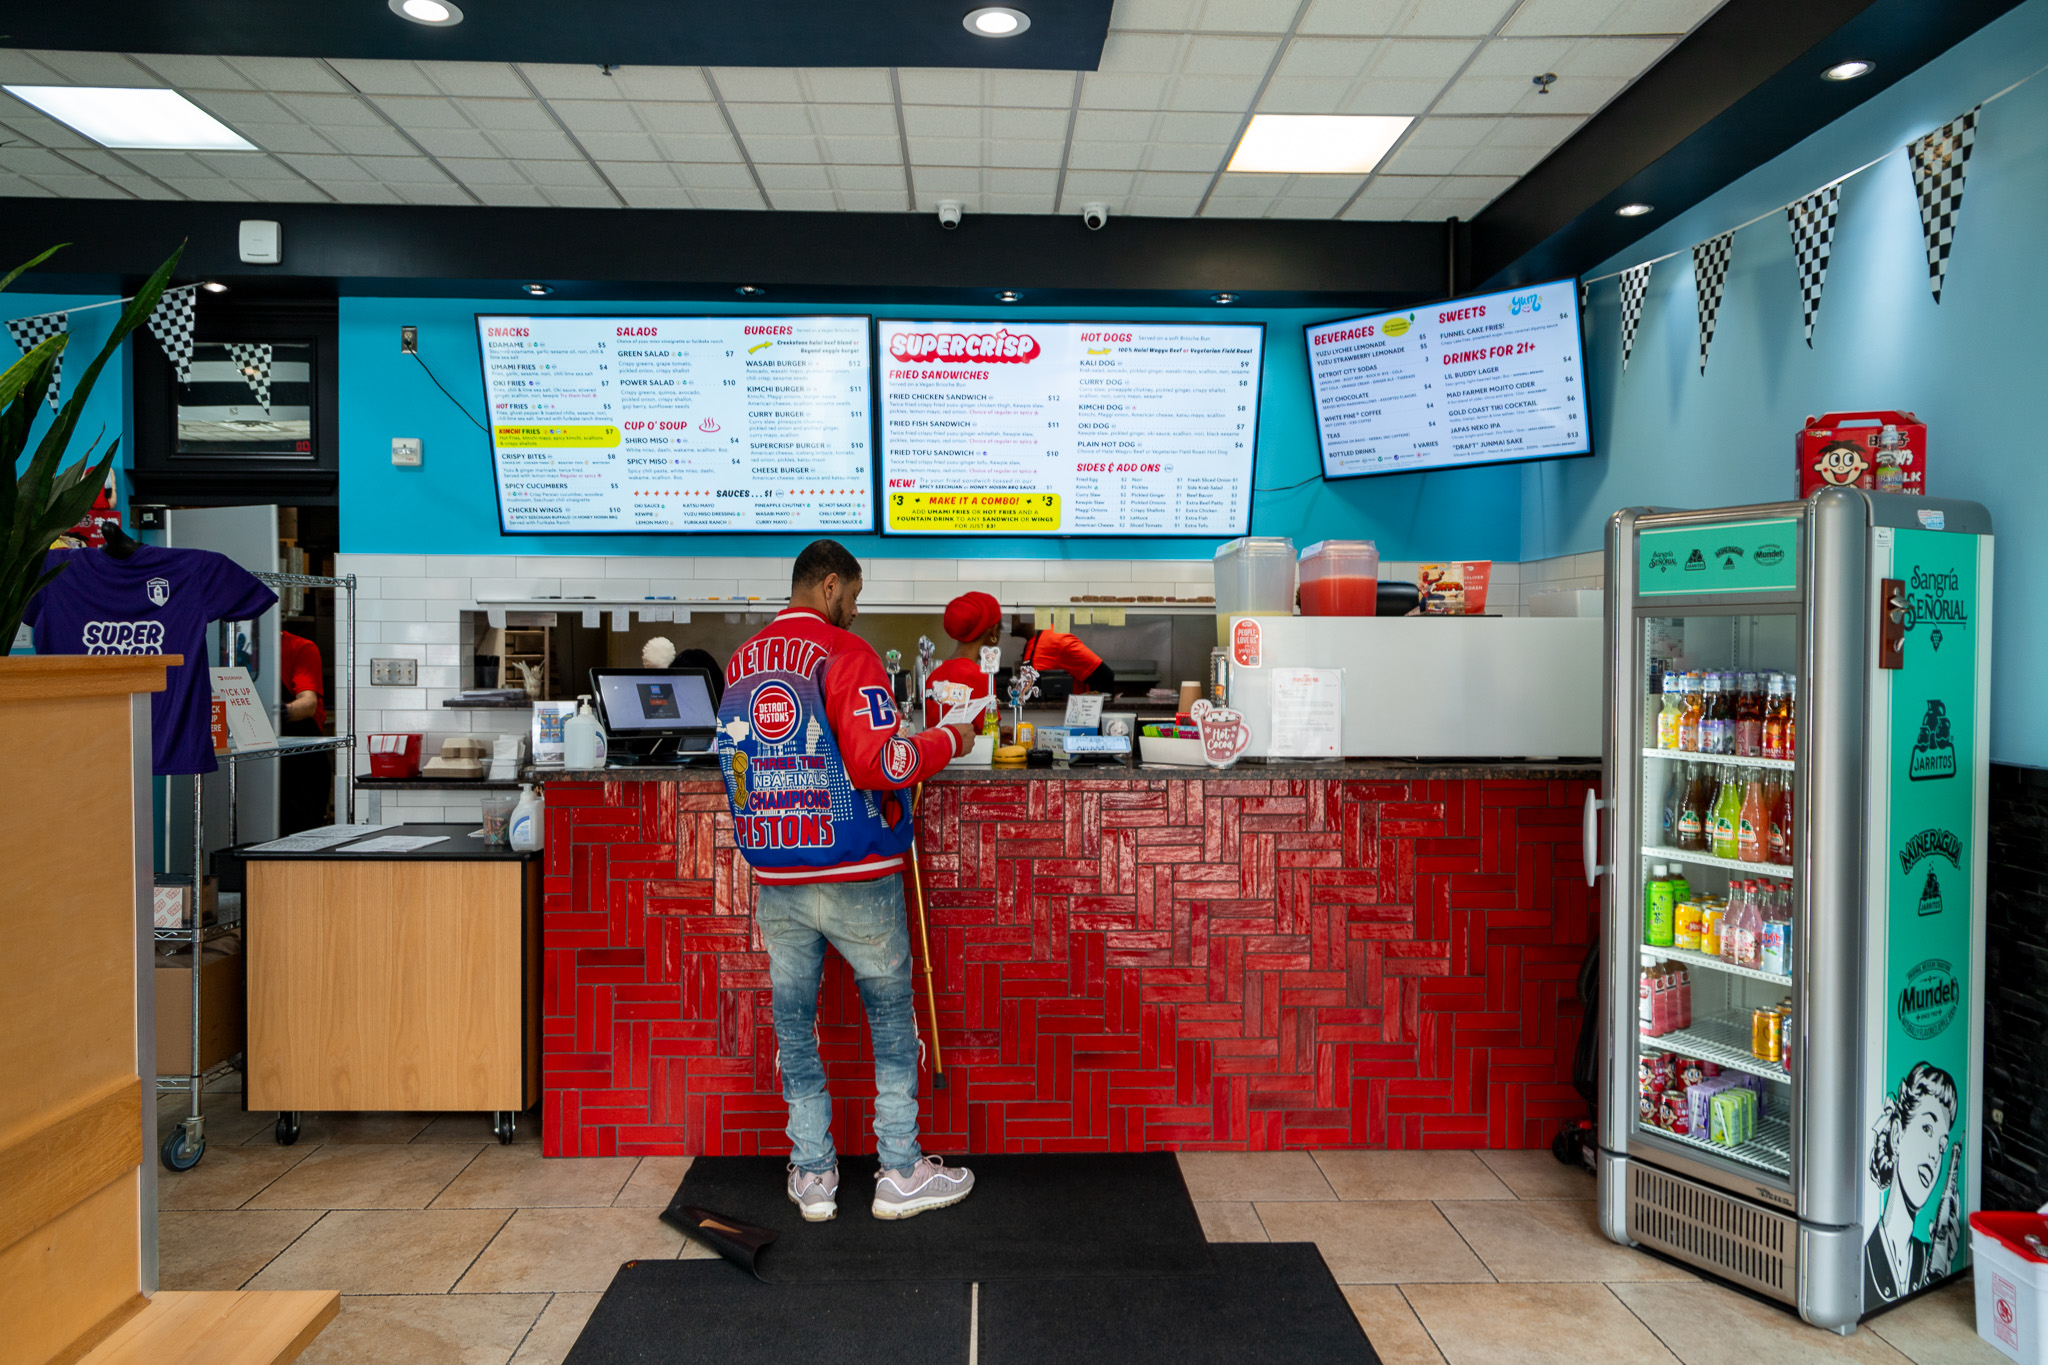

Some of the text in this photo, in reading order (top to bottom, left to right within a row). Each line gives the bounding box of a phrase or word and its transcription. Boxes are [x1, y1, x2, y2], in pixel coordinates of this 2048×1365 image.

[1439, 306, 1486, 323] SWEETS
[487, 328, 530, 337] SNACKS
[616, 327, 657, 336] SALADS
[744, 326, 793, 335] BURGERS
[1081, 333, 1132, 342] HOT DOGS
[1314, 326, 1374, 346] BEVERAGES
[1440, 323, 1505, 339] FUNNEL CAKE FRIES!
[890, 328, 1041, 364] SUPERCRISP
[1316, 341, 1386, 358] YUZU LYCHEE LEMONADE
[1334, 353, 1372, 364] STRAWBERRY
[1373, 347, 1405, 358] LEMONADE
[1443, 342, 1536, 365] DRINKS FOR 21+
[889, 370, 989, 380] FRIED SANDWICHES
[1319, 370, 1342, 379] DETROIT
[1358, 365, 1377, 373] SODAS
[1454, 370, 1477, 378] BUDDY
[1478, 367, 1499, 375] LAGER
[1463, 388, 1488, 396] FARMER
[1489, 384, 1514, 393] MOJITO
[1516, 381, 1536, 389] CIDER
[1336, 392, 1369, 402] CHOCOLATE
[1361, 410, 1382, 418] COFFEE
[1449, 409, 1465, 417] GOLD
[1466, 406, 1489, 414] COAST
[1504, 401, 1537, 410] COCKTAIL
[624, 421, 645, 430] CUP
[660, 422, 687, 430] SOUP
[1450, 426, 1470, 434] JAPAS
[1480, 440, 1505, 448] JUNMAI
[1329, 450, 1354, 458] BOTTLED
[1077, 463, 1106, 471] SIDES
[1116, 464, 1137, 472] ADD
[1140, 464, 1161, 472] ONS
[889, 479, 916, 488] NEW!
[929, 497, 1019, 505] MAKE IT A COMBO!
[1756, 550, 1782, 558] Mundet
[1911, 565, 1959, 598] Sangría
[82, 621, 165, 647] SUPER
[726, 637, 829, 689] DETROIT
[230, 698, 251, 706] HERE
[758, 701, 788, 713] DETROIT
[758, 712, 790, 724] PISTONS
[1213, 727, 1232, 740] Hot
[1207, 737, 1235, 751] Cocoa
[752, 755, 826, 771] THREE TIME
[1914, 754, 1952, 772] JARRITOS
[755, 773, 829, 787] NBA FINALS
[749, 790, 831, 811] CHAMPIONS
[735, 813, 835, 849] PISTONS
[1900, 828, 1963, 876] MINERAGUA
[1901, 976, 1956, 1015] Mundet
